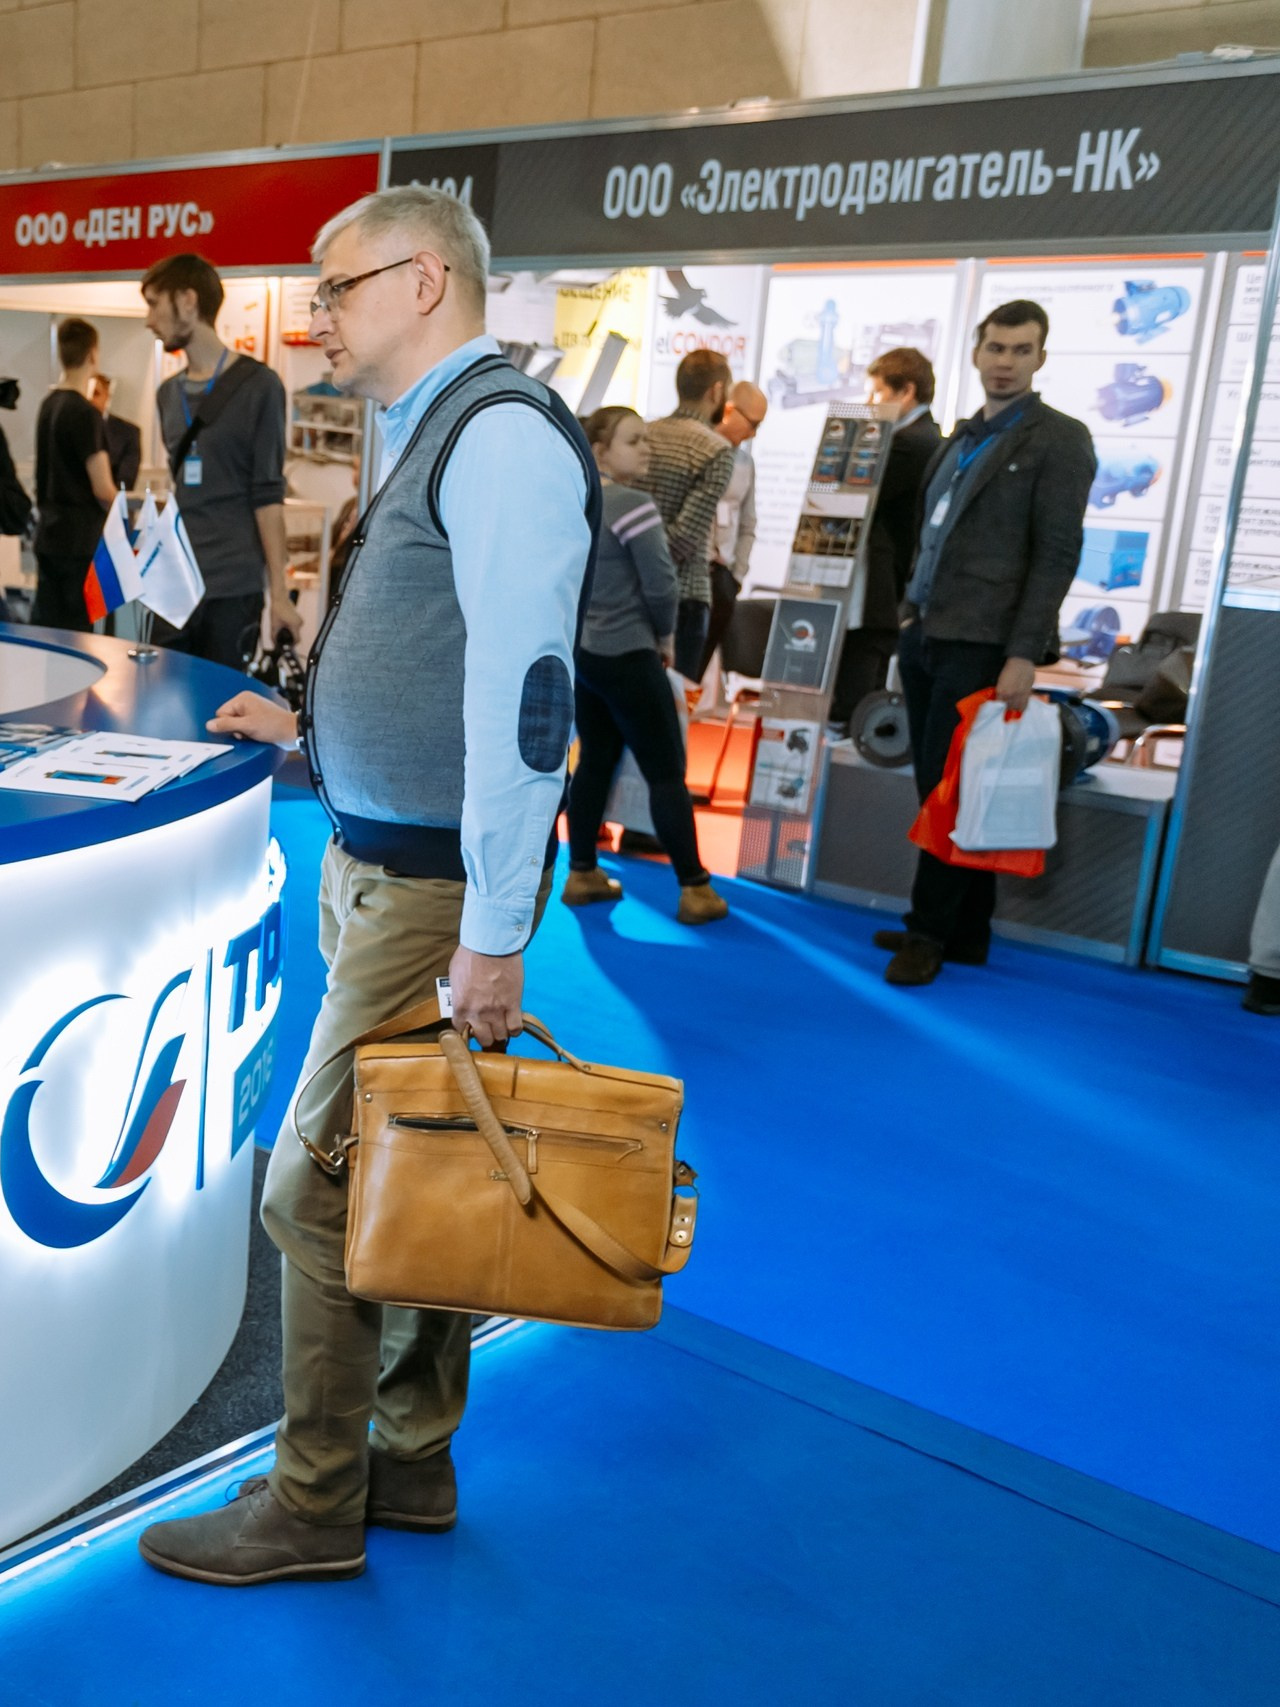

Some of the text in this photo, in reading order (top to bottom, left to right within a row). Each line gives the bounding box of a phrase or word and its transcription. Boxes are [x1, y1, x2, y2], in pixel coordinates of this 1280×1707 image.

[604, 127, 1161, 222] ООО «Электродвигатель-НК»
[15, 201, 215, 248] ООО «ДЕН РУС»
